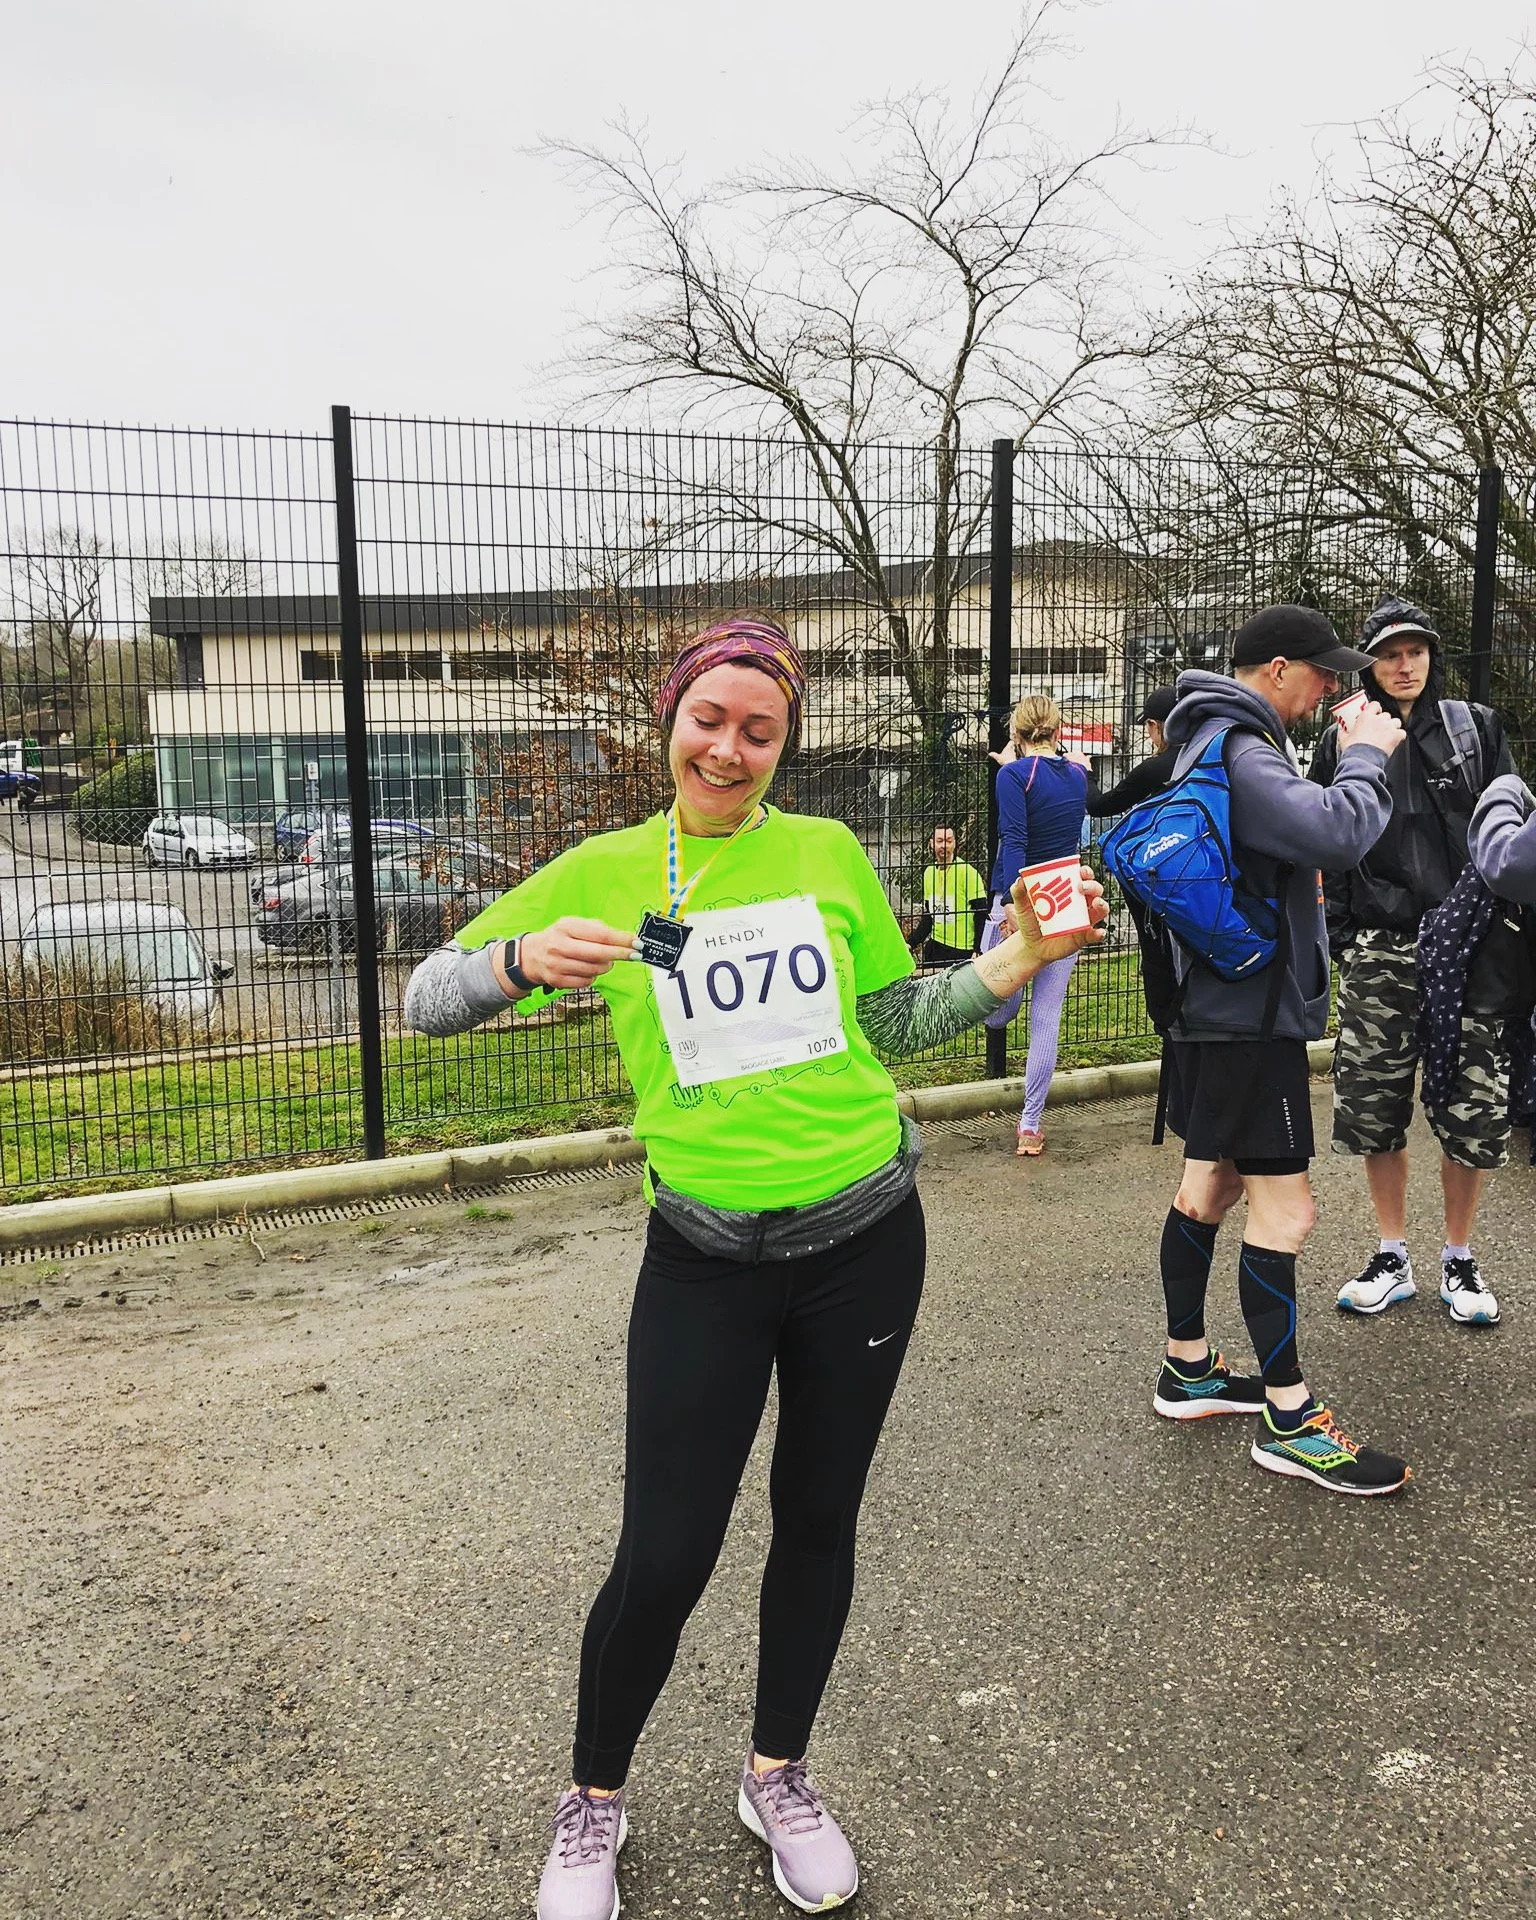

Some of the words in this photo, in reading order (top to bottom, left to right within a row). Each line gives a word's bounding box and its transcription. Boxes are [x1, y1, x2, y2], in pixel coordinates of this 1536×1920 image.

[1149, 837, 1180, 859] Andes
[705, 927, 765, 948] HENDY
[667, 944, 826, 1019] 1070
[807, 1037, 837, 1054] 1070
